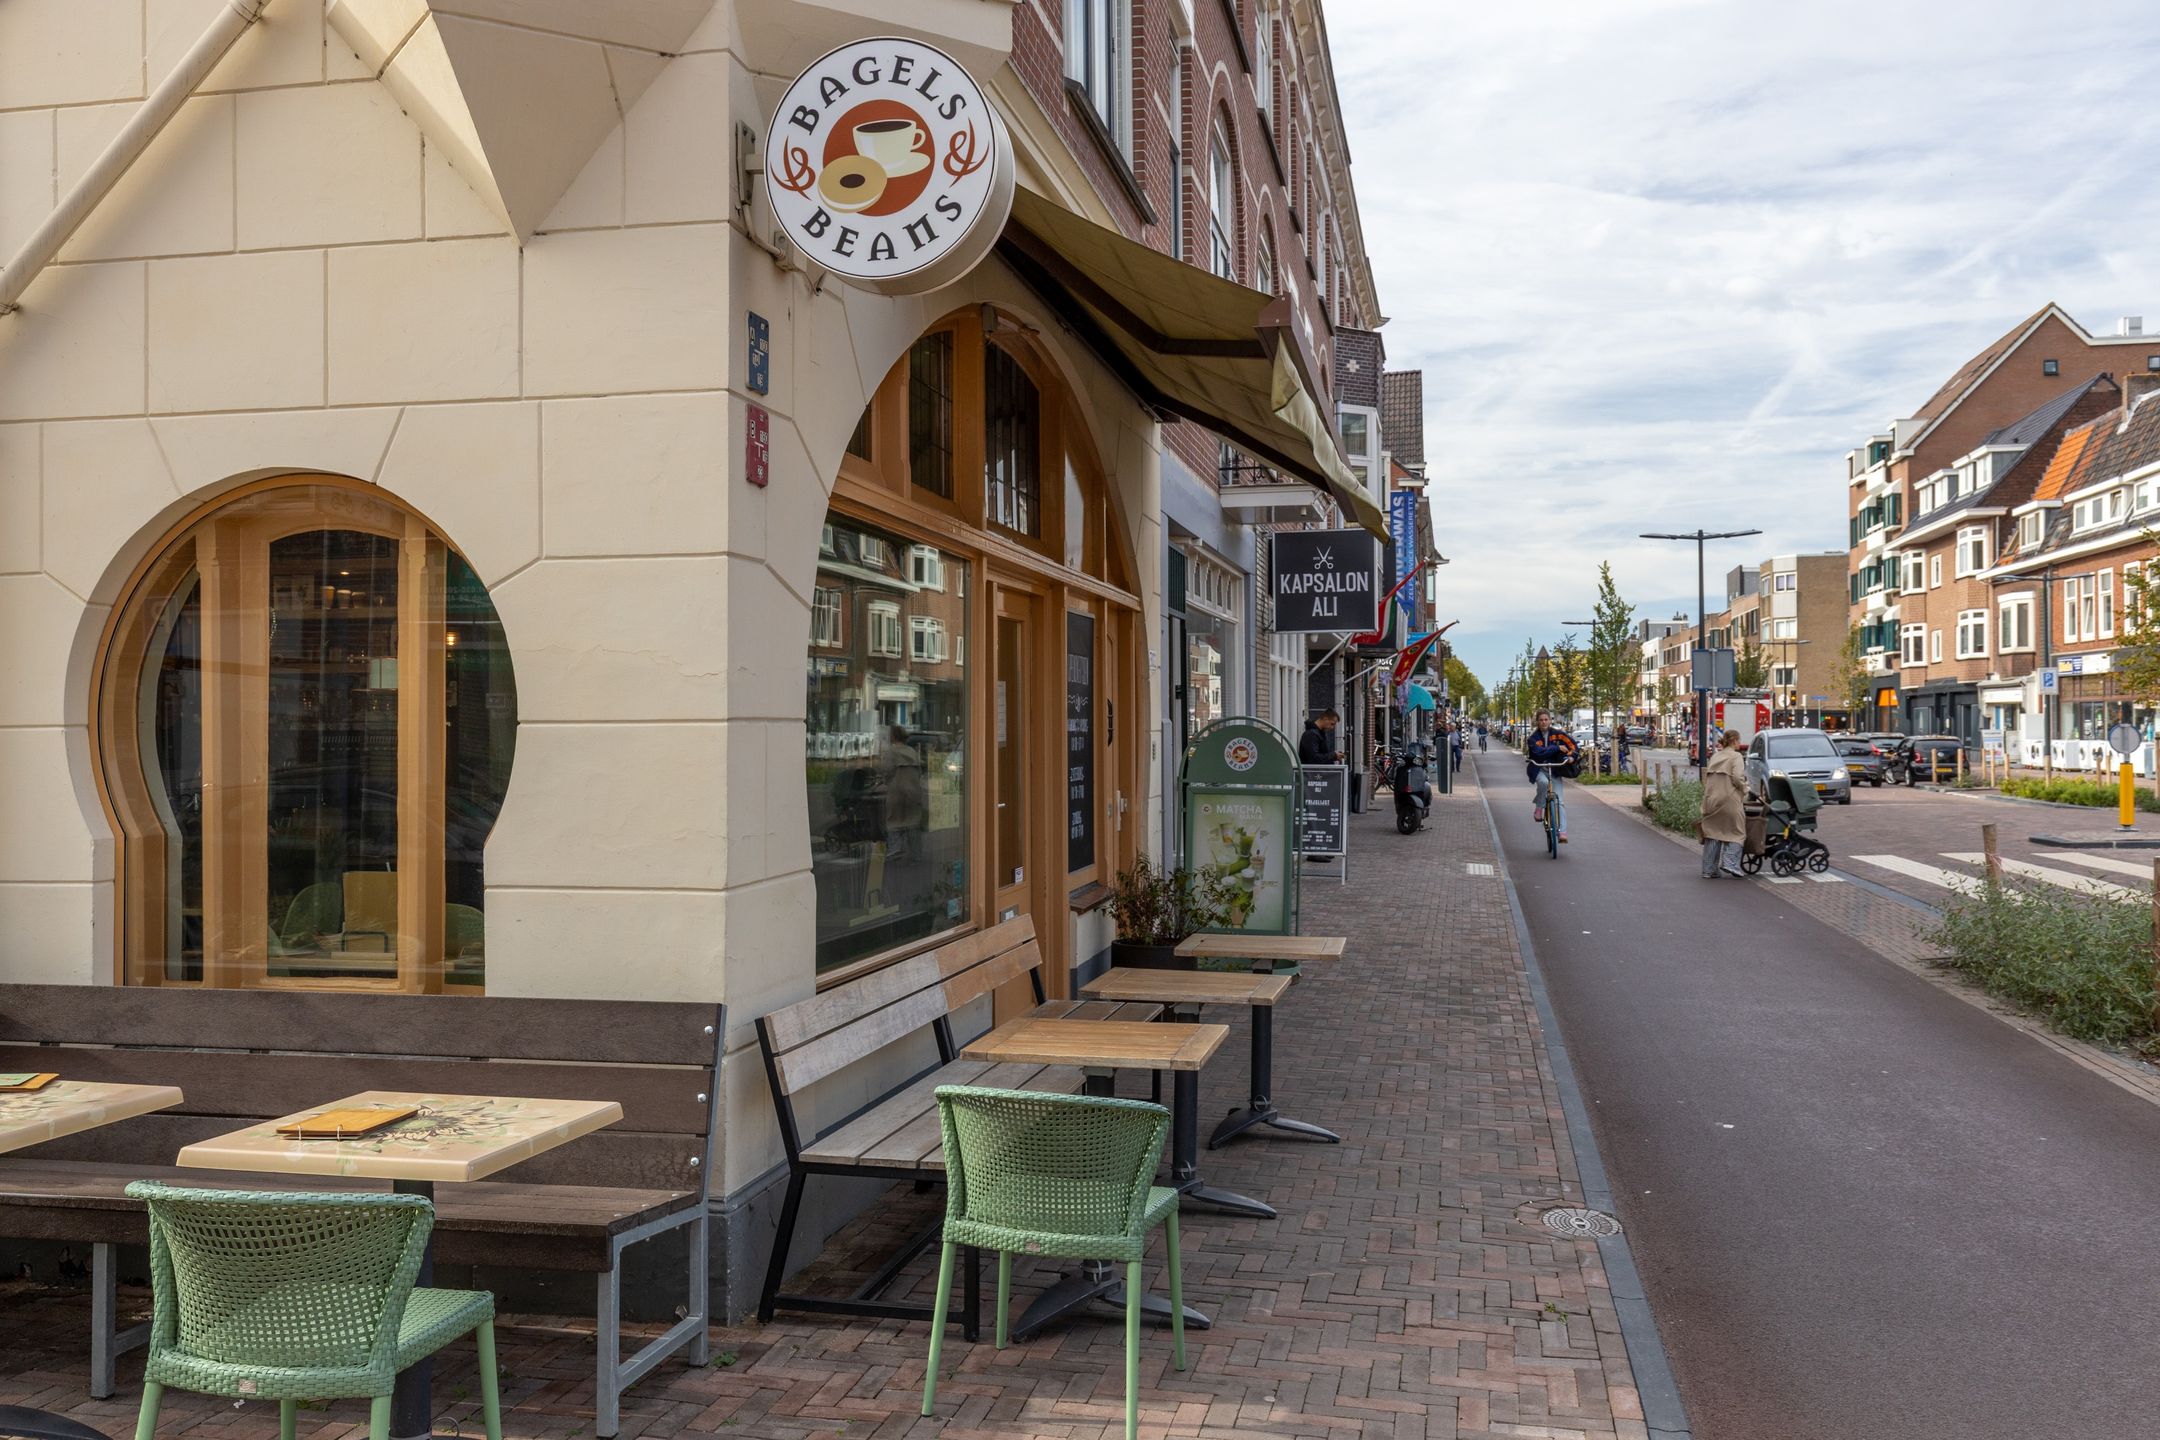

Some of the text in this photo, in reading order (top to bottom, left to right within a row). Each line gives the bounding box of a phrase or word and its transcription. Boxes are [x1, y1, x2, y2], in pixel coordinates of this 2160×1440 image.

[788, 55, 967, 135] BAGELS
[800, 194, 962, 262] BEANS
[1280, 571, 1369, 594] KAPSALON
[1311, 596, 1338, 617] ALI
[1216, 804, 1263, 815] MATCHA
